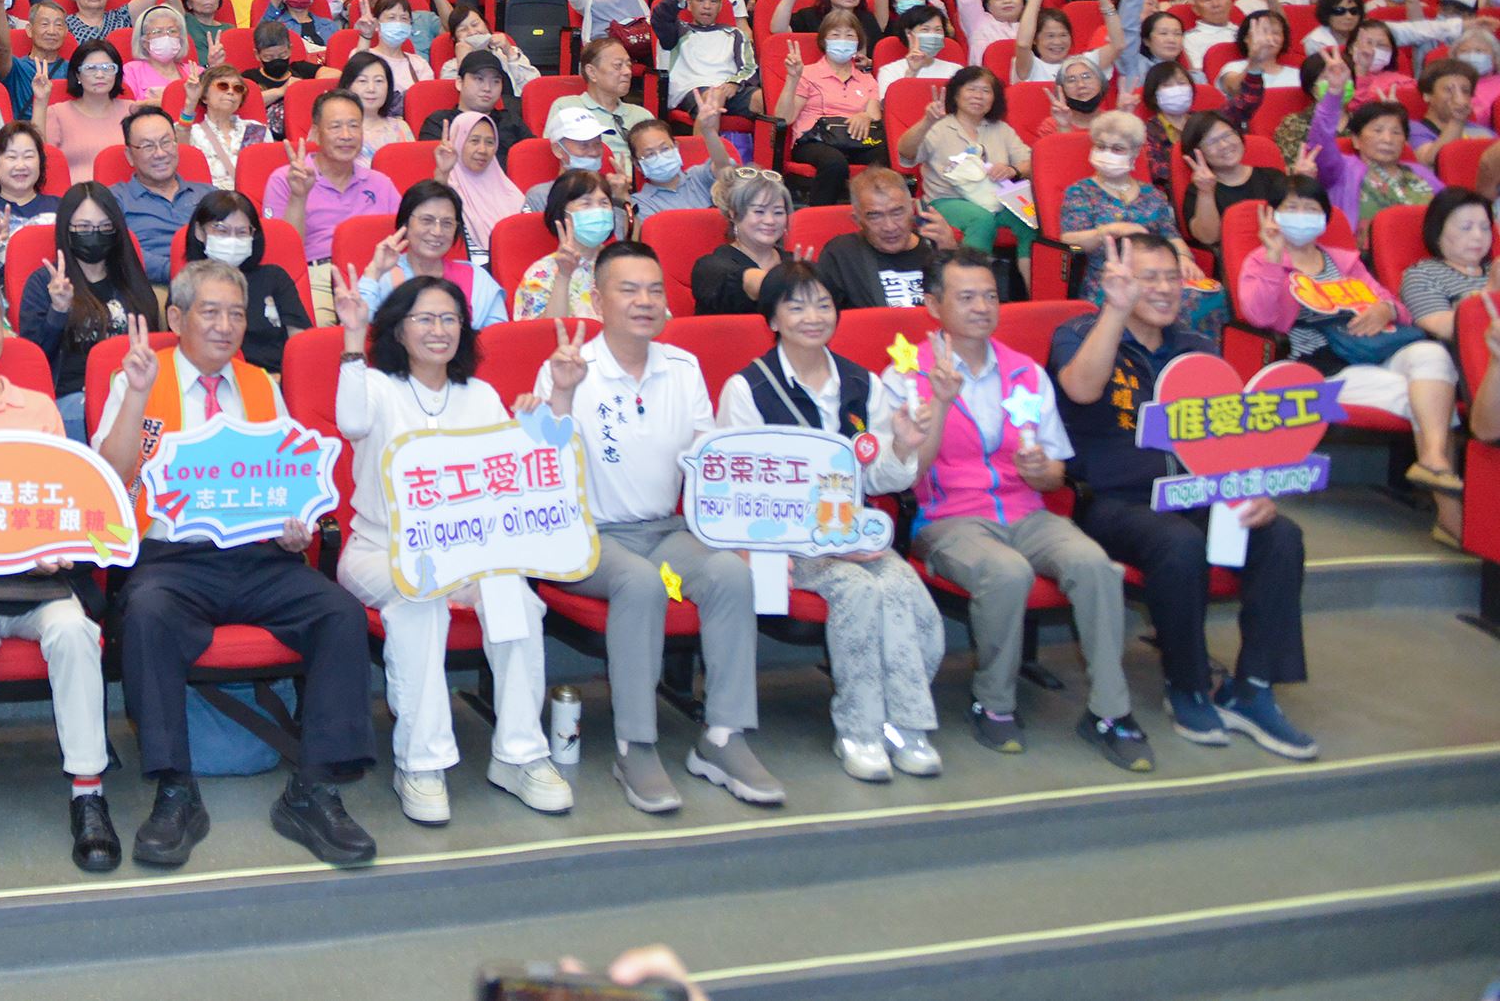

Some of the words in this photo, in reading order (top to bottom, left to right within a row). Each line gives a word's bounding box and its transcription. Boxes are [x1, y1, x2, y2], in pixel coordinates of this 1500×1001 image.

[163, 463, 220, 481] Love
[231, 459, 321, 480] Online.
[702, 454, 810, 484] 苗栗志工
[196, 486, 288, 509] 志工上線
[406, 521, 429, 547] zii
[503, 506, 520, 532] oi
